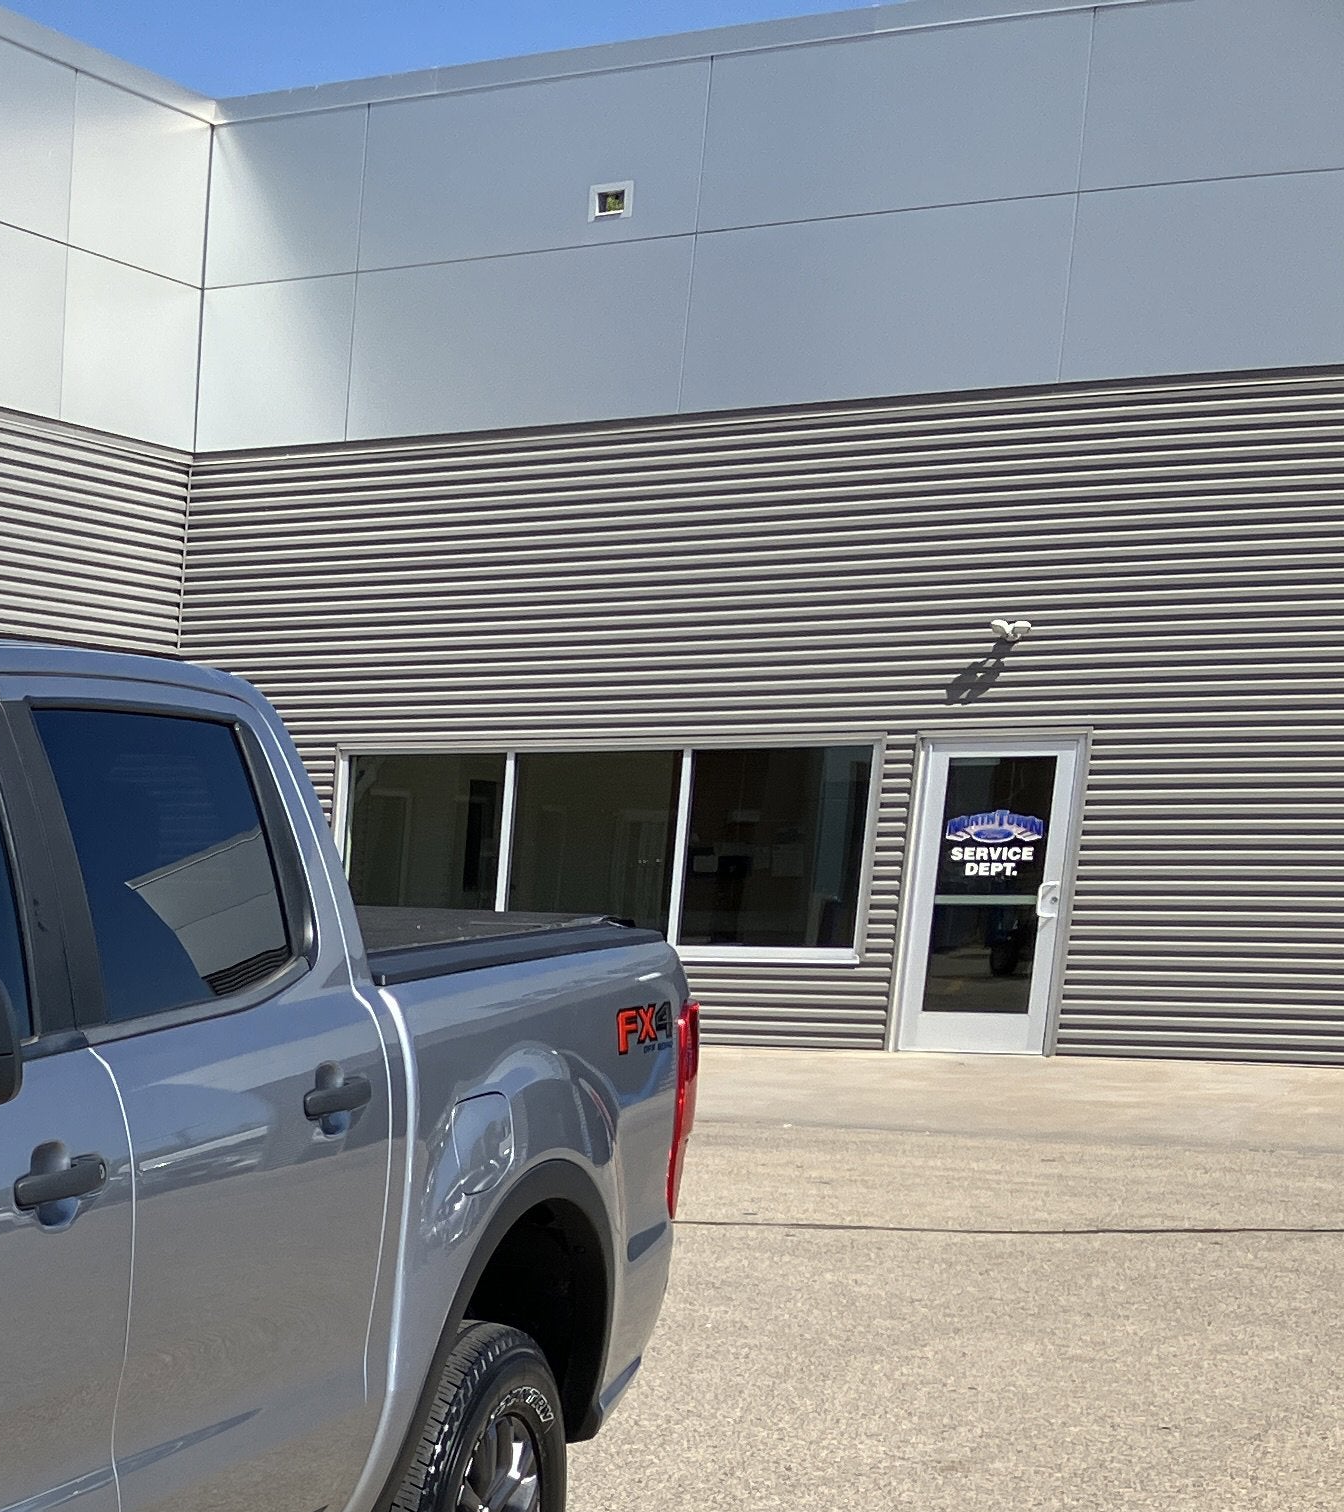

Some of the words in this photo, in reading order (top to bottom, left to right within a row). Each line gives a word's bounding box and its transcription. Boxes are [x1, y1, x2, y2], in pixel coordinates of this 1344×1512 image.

[951, 846, 1034, 861] SERVICE
[965, 862, 1017, 876] DEPT.
[616, 1000, 673, 1056] FX4
